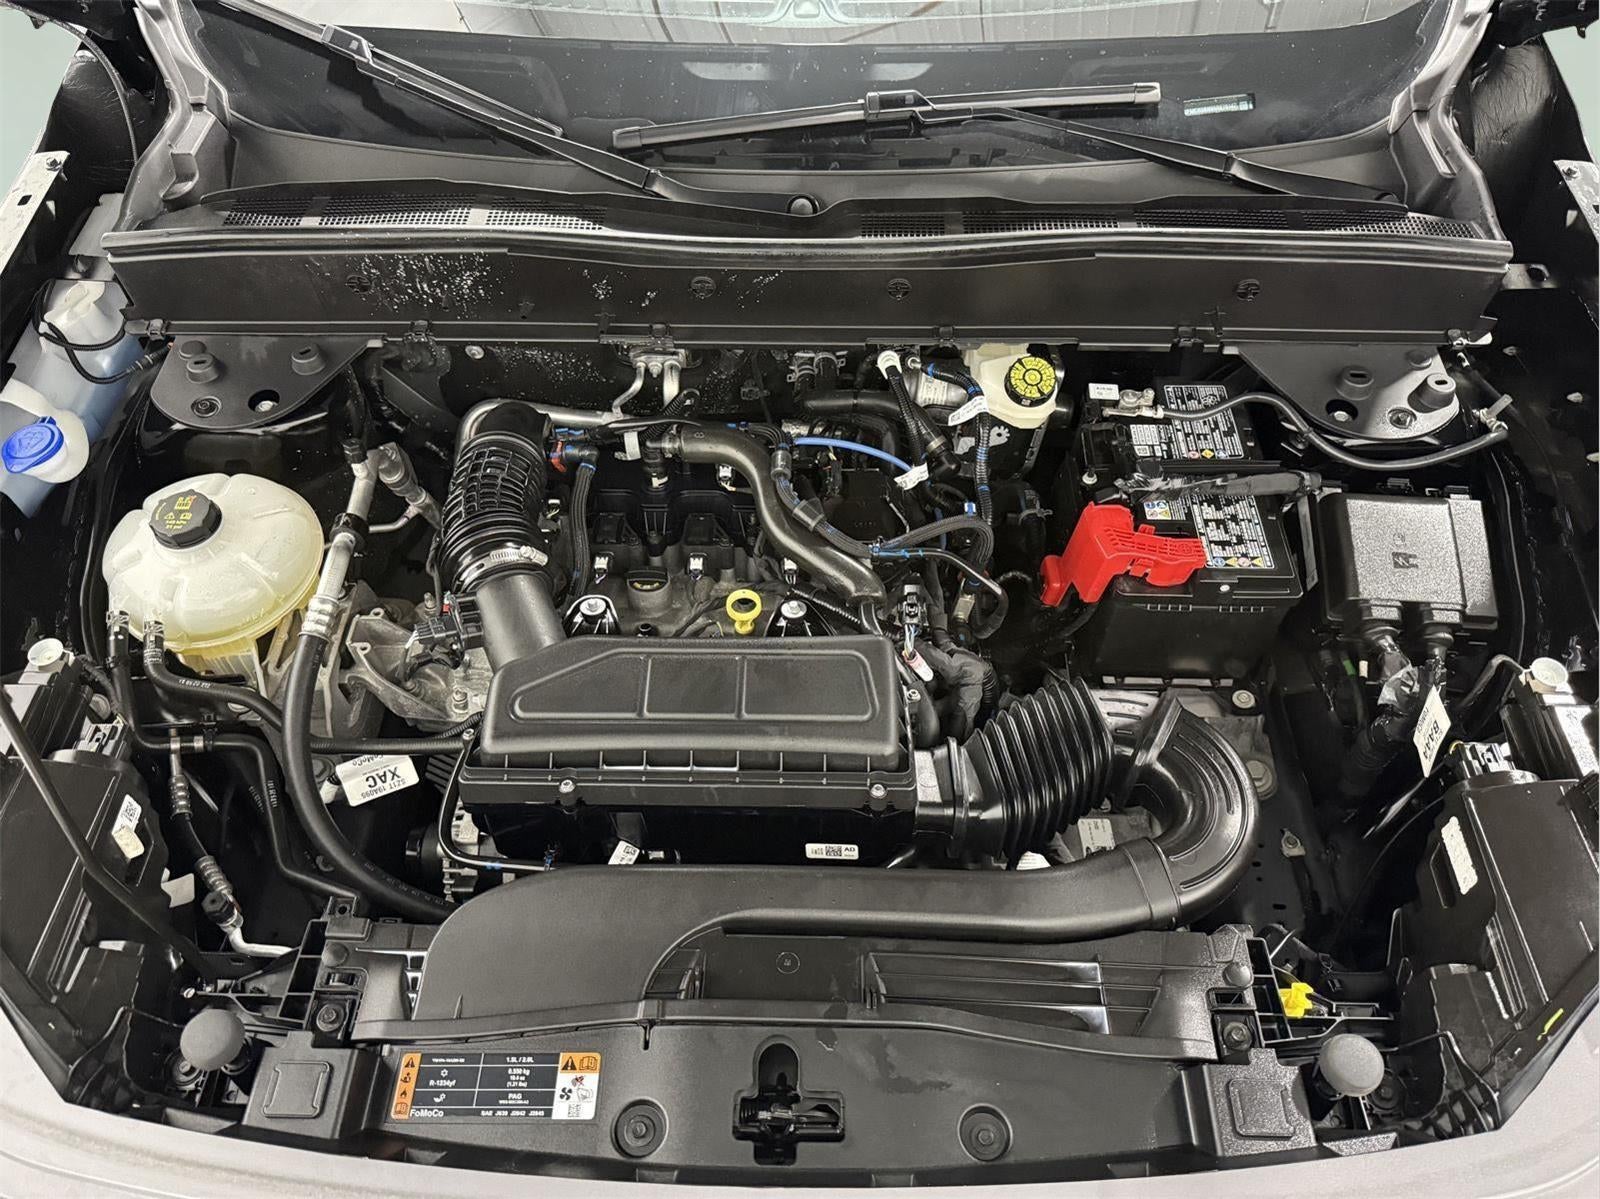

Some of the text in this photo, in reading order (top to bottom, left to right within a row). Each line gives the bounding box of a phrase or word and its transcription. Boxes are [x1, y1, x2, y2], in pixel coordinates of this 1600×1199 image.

[365, 766, 401, 789] XAC
[429, 1079, 456, 1088] R-1234yf
[508, 1092, 522, 1100] PAG
[410, 1108, 444, 1118] FoMoCo
